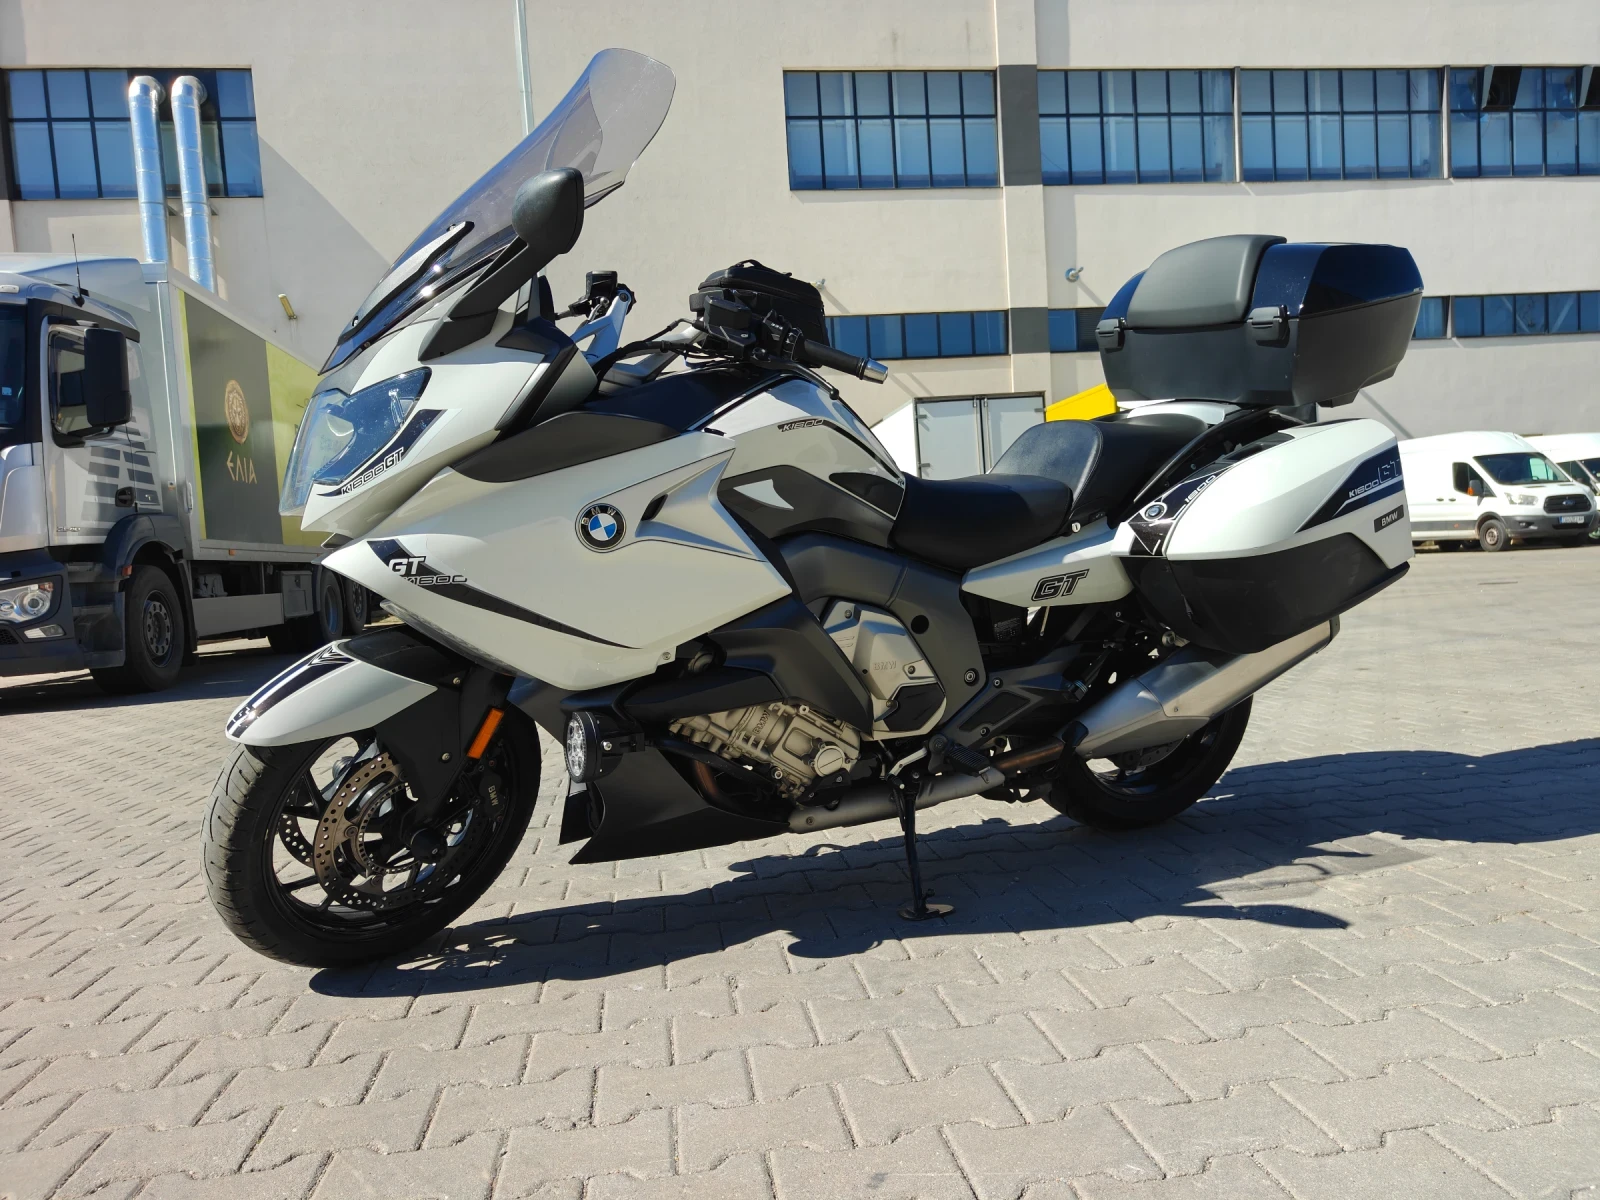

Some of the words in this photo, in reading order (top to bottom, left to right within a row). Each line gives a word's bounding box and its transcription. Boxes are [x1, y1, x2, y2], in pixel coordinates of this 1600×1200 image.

[581, 505, 617, 526] BMW
[1381, 510, 1399, 527] BMW
[388, 556, 427, 576] GT
[1031, 568, 1090, 602] GT
[488, 785, 499, 806] BMW
